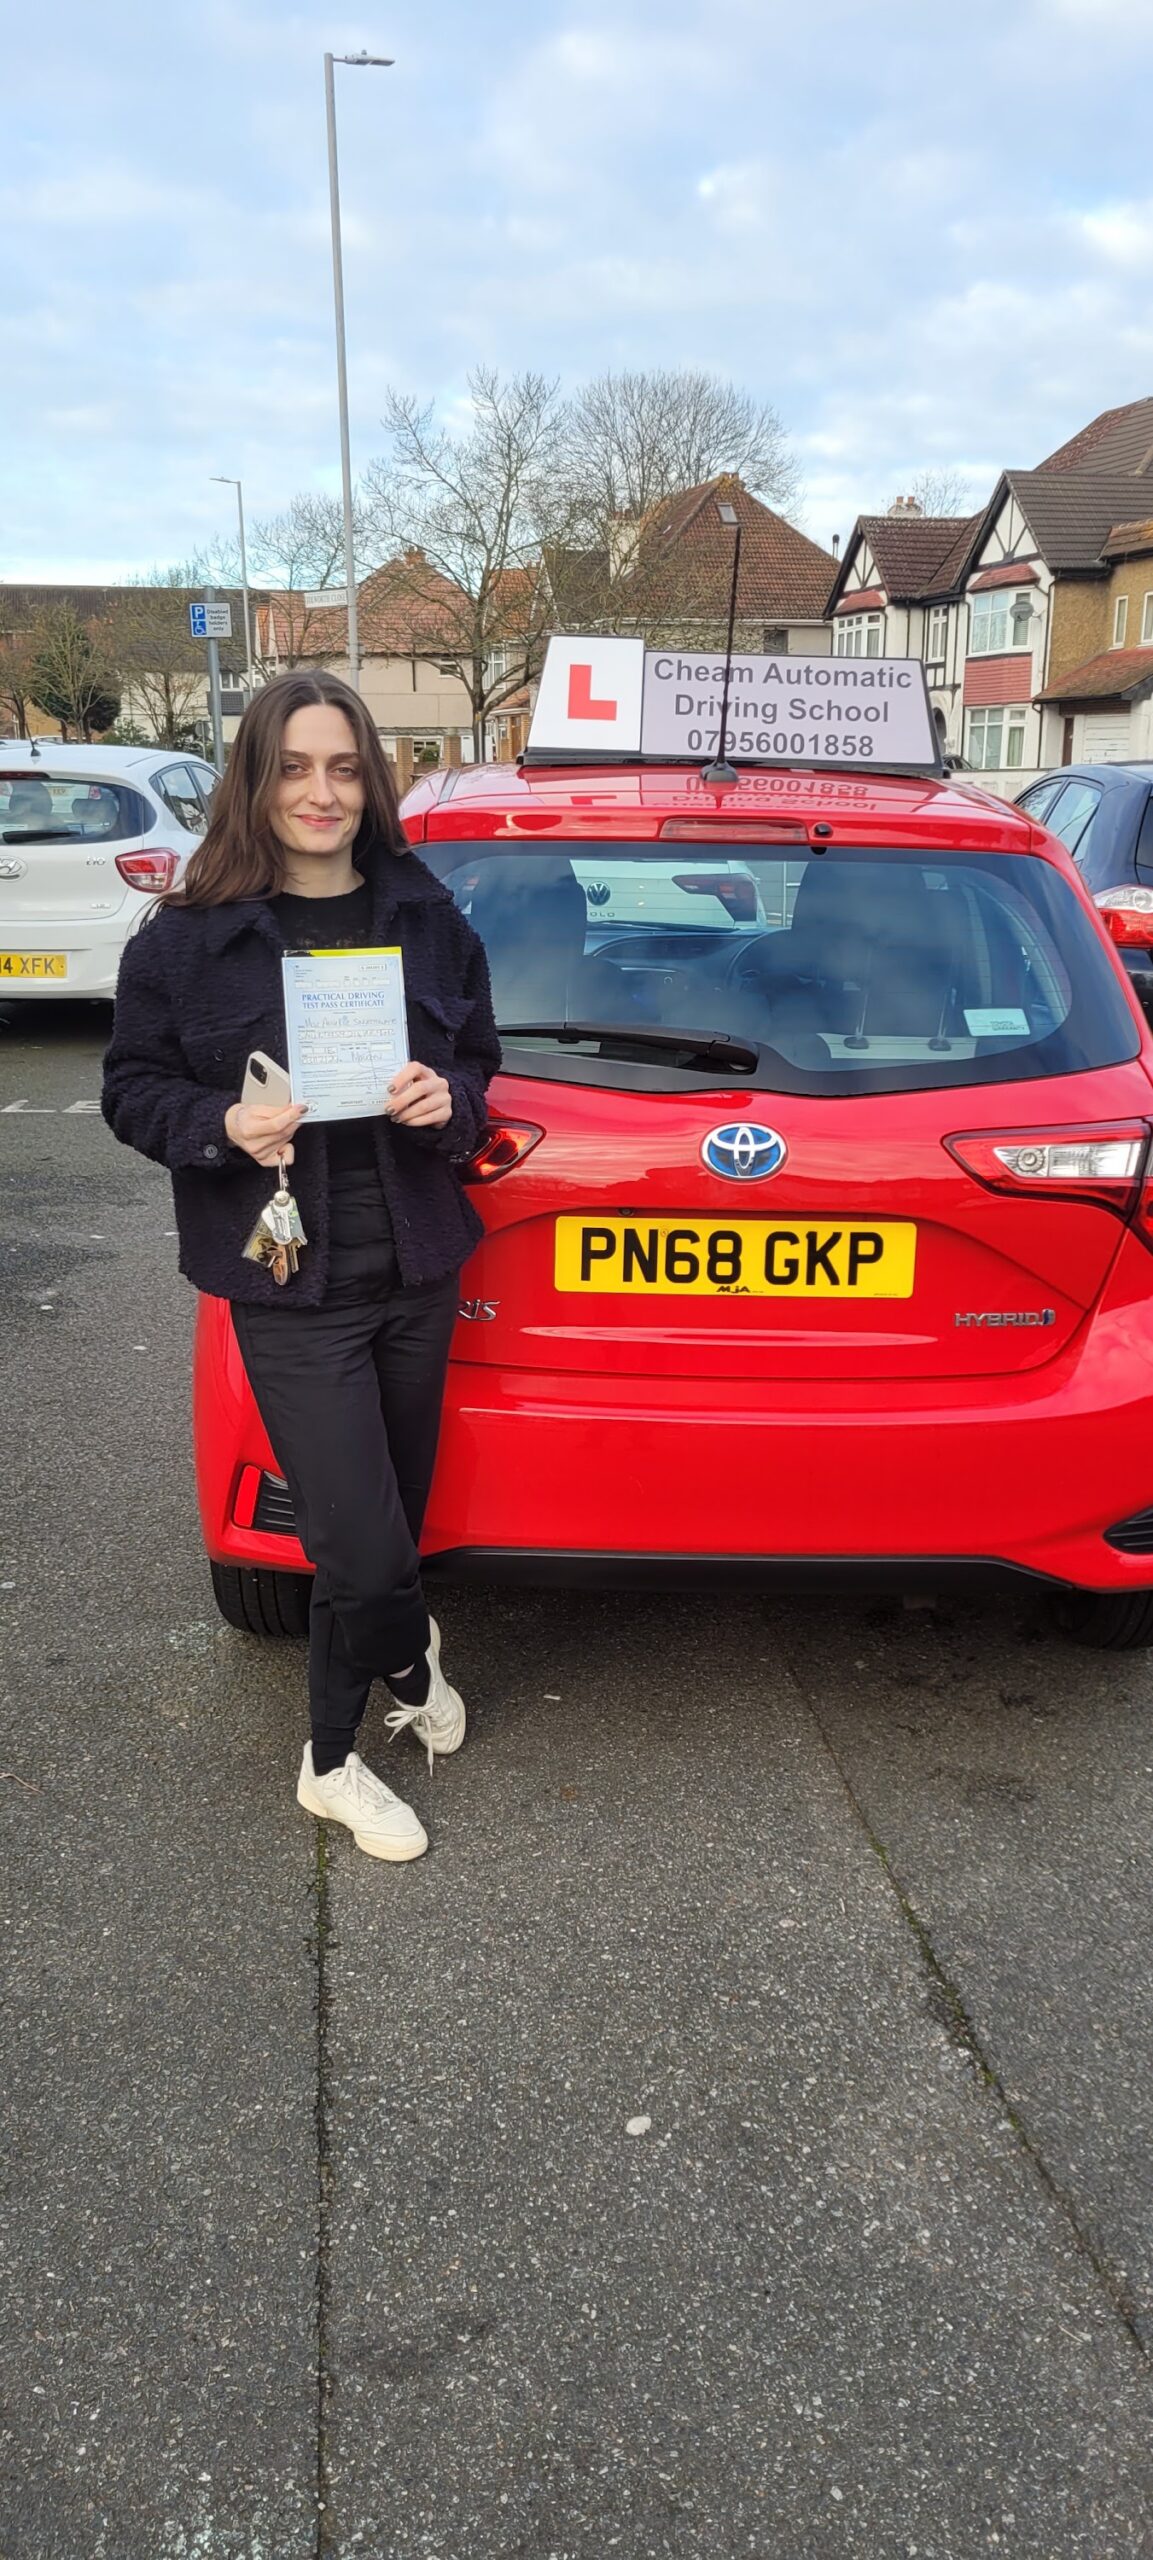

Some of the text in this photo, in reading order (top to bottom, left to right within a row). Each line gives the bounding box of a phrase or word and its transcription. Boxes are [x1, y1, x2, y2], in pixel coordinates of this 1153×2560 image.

[194, 607, 204, 619] P
[654, 659, 912, 689] Cheam Automatic
[567, 664, 617, 721] L
[674, 694, 888, 724] Driving School
[687, 729, 874, 757] 07956001858
[20, 957, 56, 975] XFK
[302, 991, 385, 1001] PRACTICAL DRIVING
[340, 1000, 385, 1008] CERTIFICATE
[581, 1227, 885, 1286] PN68 GKP
[955, 1313, 1040, 1327] HYBRID
